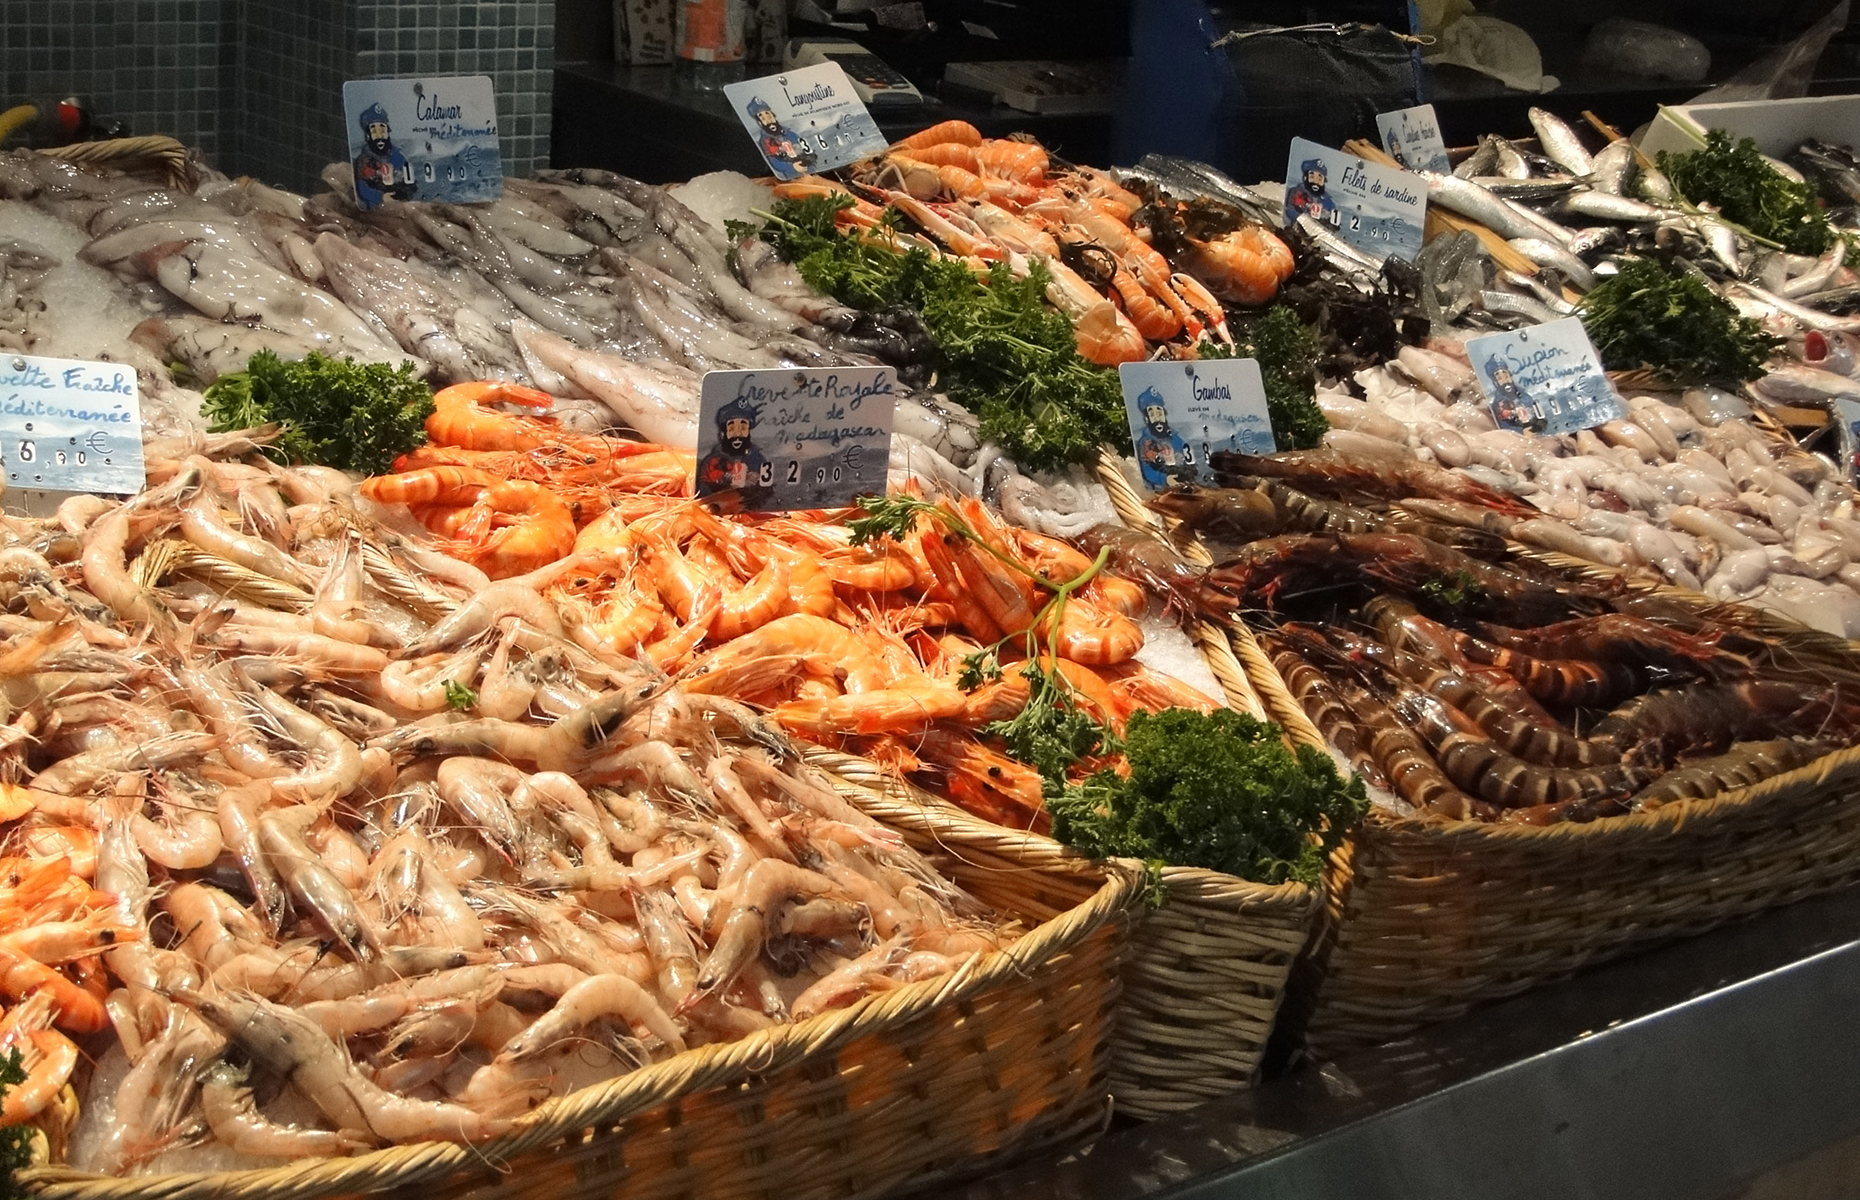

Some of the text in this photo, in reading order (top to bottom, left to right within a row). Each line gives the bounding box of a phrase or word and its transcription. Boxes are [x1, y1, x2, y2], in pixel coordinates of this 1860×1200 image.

[417, 94, 463, 121] Calamar
[783, 82, 835, 110] Langoustine
[1341, 166, 1419, 206] Filets de sardine
[1505, 343, 1569, 375] Supion
[825, 371, 895, 411] Royale
[1193, 375, 1232, 402] Gambas
[827, 402, 845, 420] de
